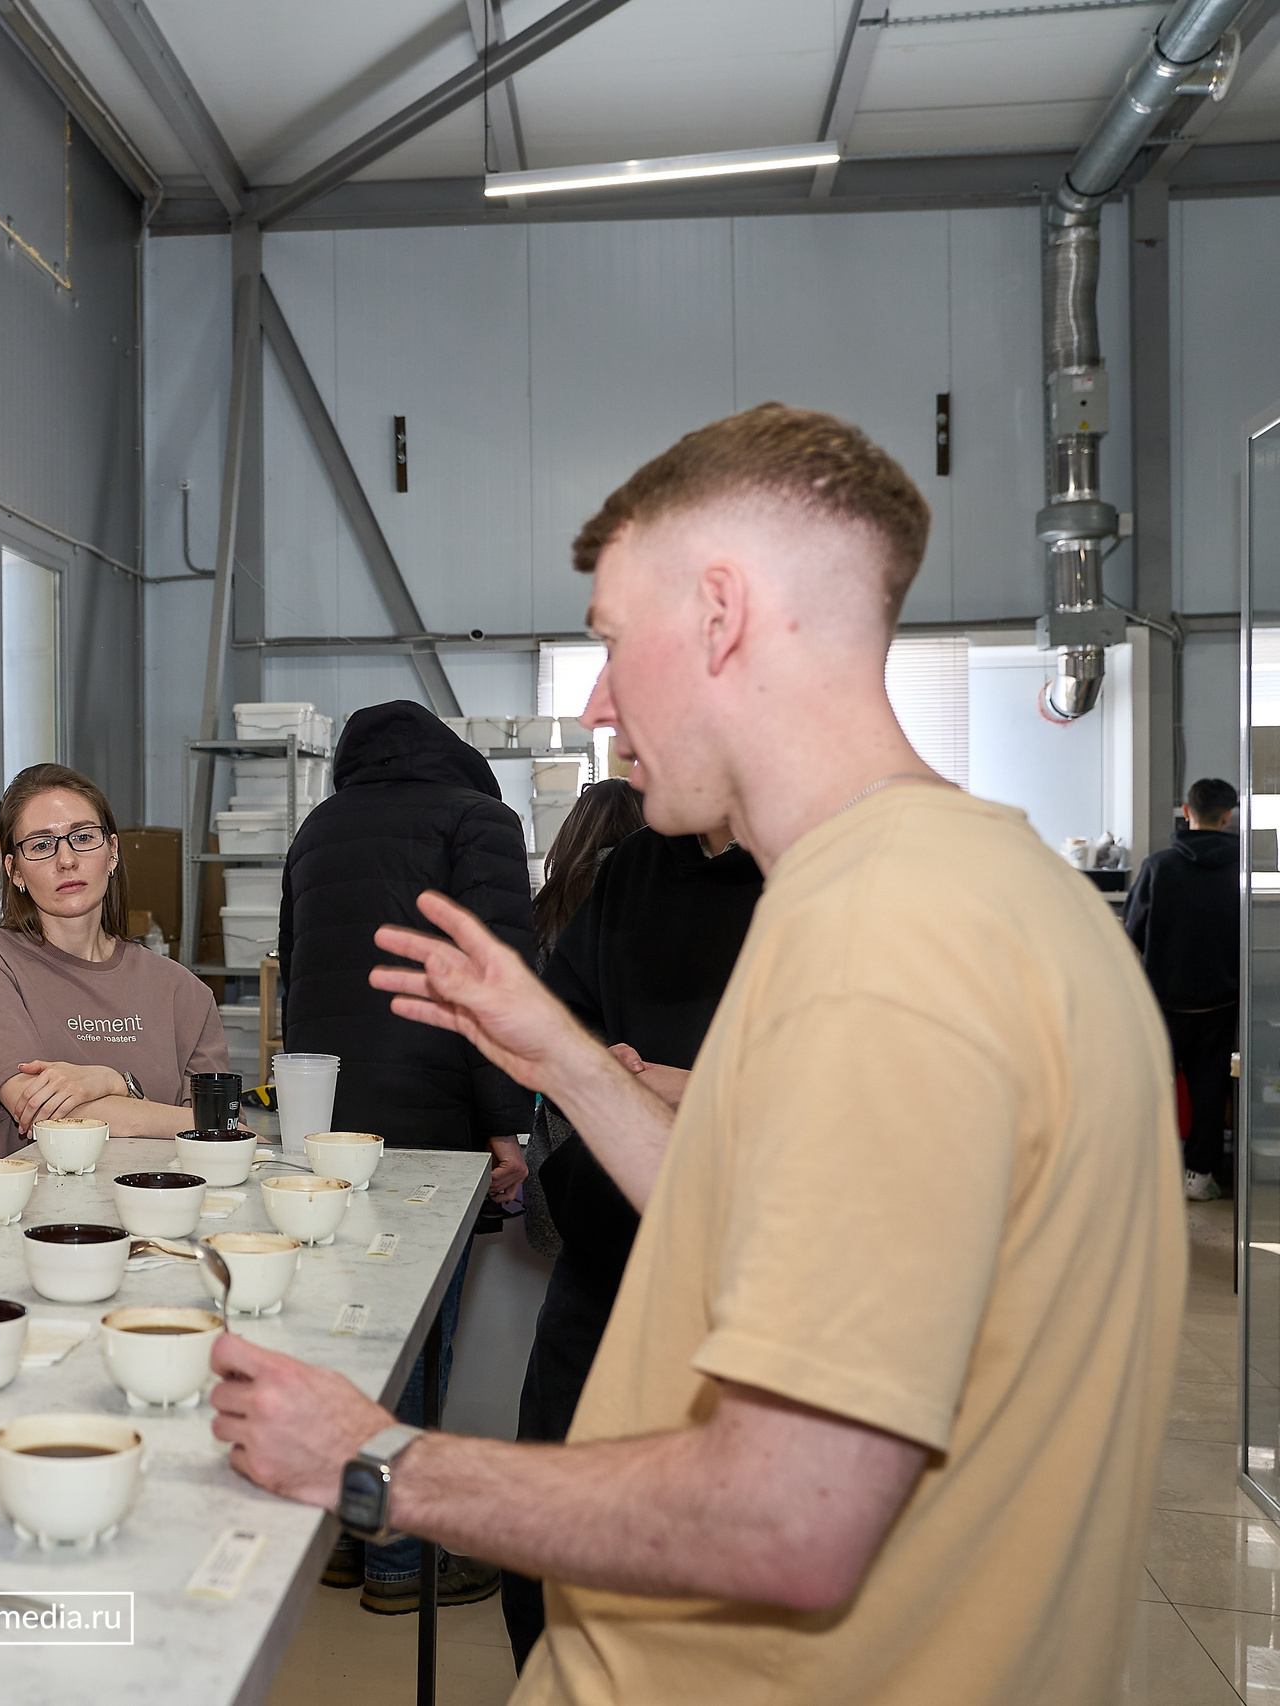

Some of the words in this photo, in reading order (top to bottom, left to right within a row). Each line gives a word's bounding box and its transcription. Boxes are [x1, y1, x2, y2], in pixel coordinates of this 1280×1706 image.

[67, 1014, 144, 1033] element
[76, 1034, 101, 1042] coffee
[104, 1035, 137, 1043] roasters
